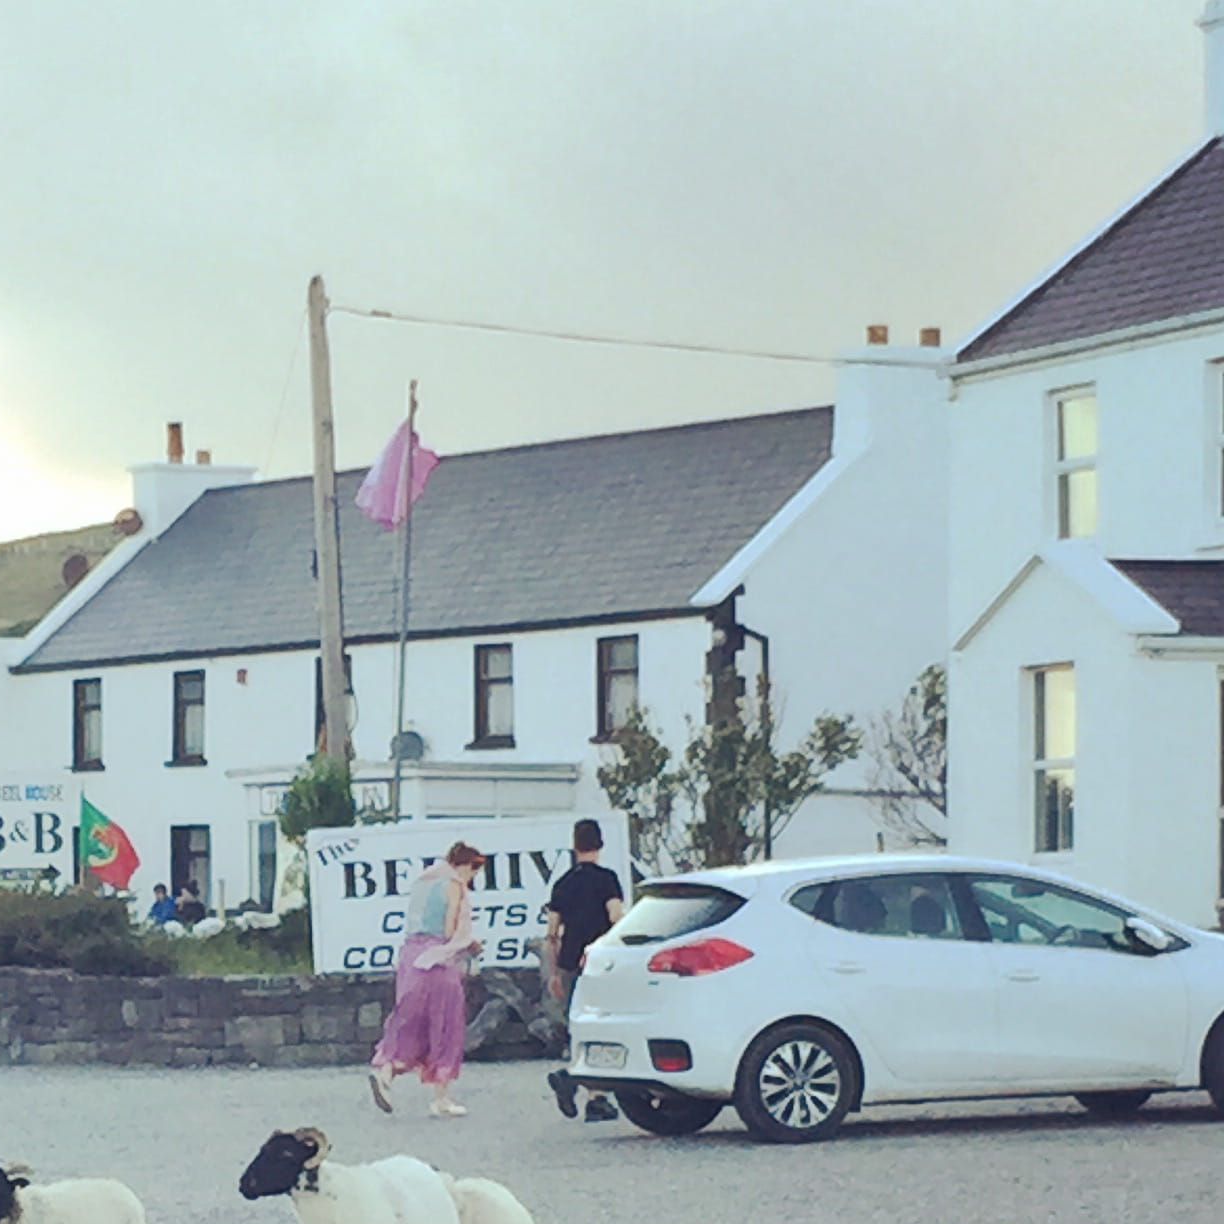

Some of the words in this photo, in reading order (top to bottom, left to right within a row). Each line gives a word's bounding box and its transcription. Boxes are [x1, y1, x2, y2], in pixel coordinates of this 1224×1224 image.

[25, 785, 63, 801] HOUSE
[316, 838, 360, 866] The
[340, 849, 576, 899] BEHIV
[381, 904, 529, 933] CTS
